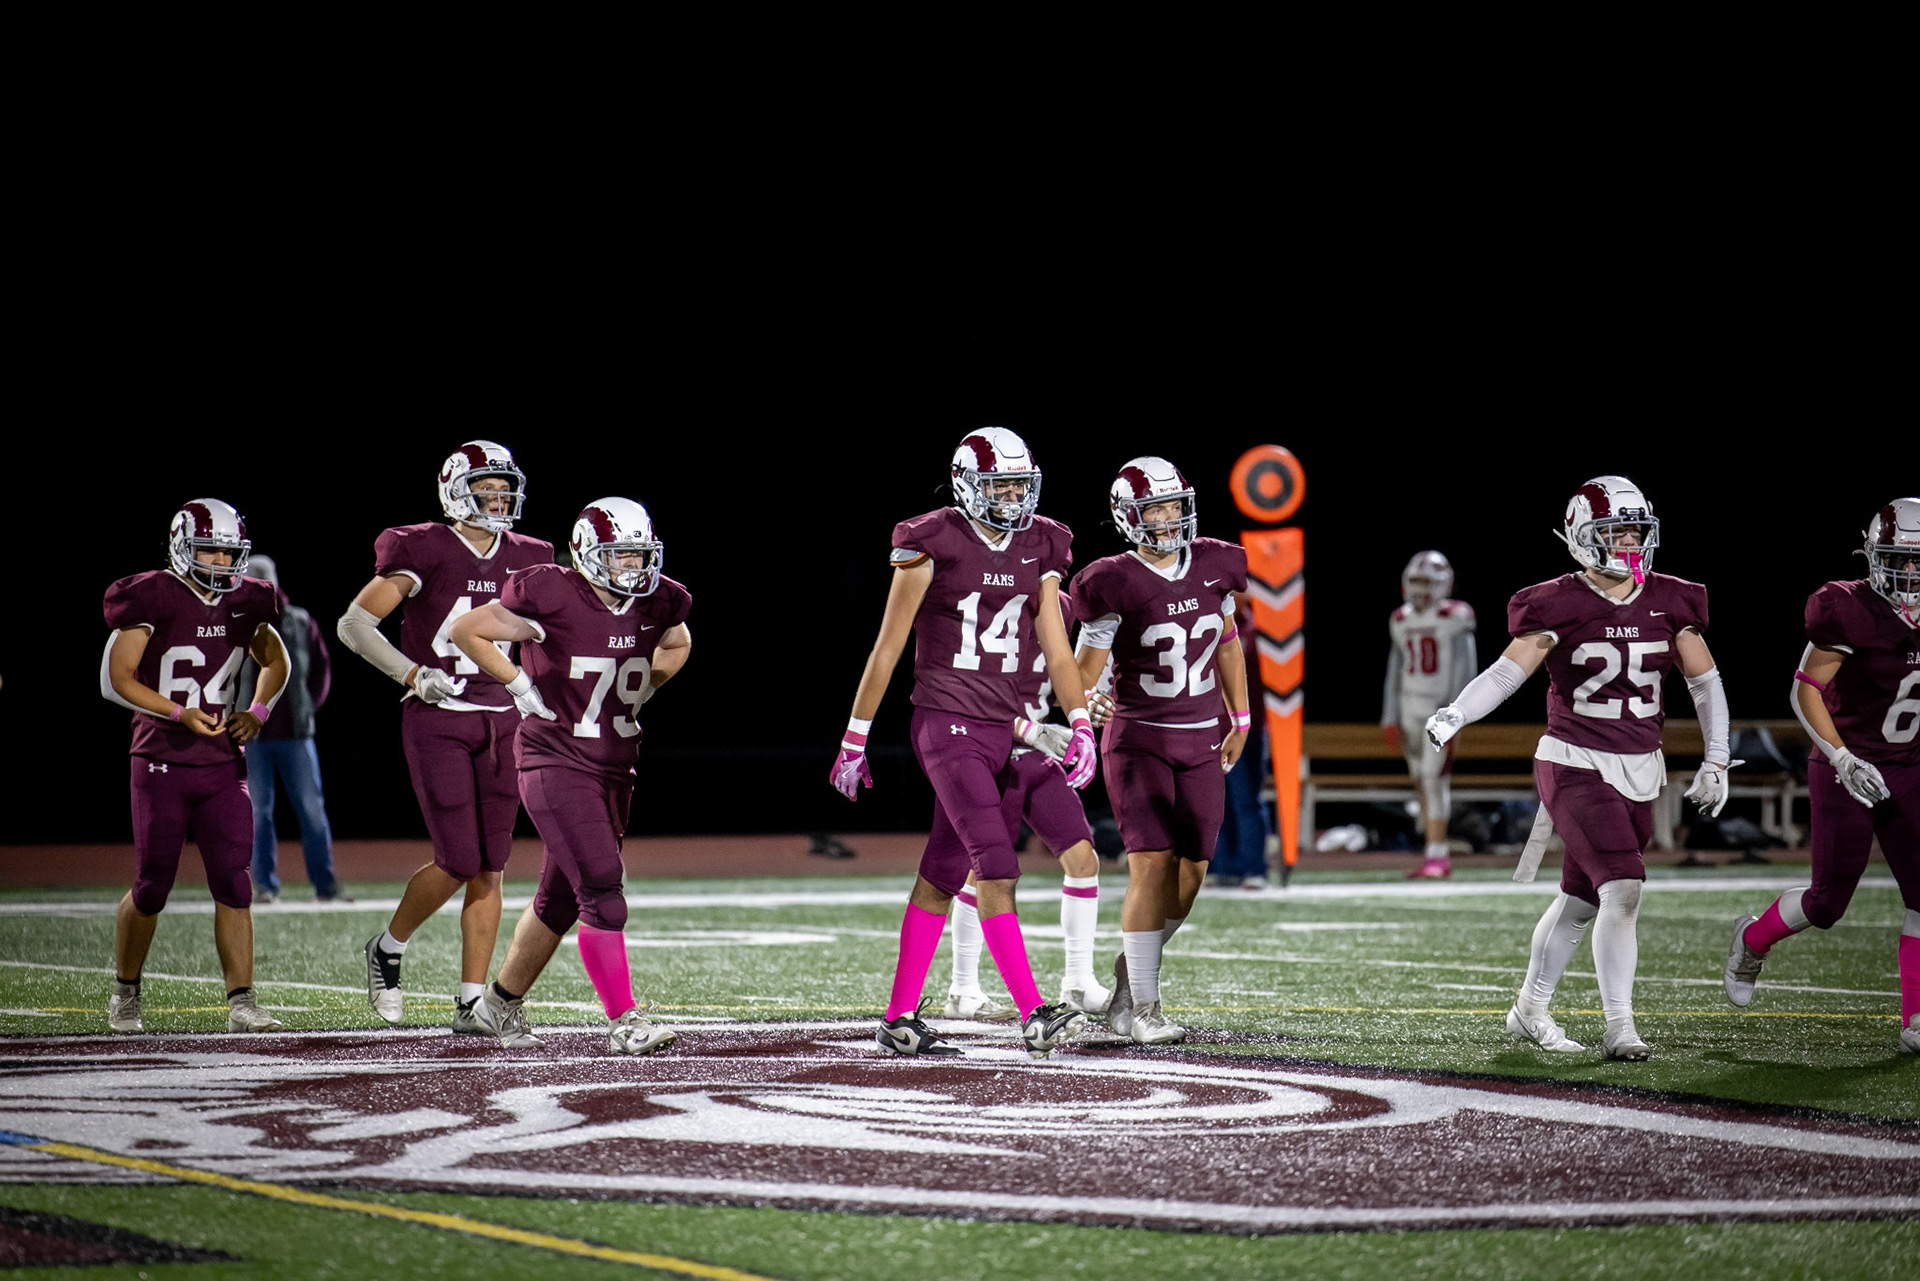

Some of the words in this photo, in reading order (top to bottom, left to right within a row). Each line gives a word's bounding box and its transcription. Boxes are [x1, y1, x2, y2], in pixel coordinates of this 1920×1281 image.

[467, 580, 497, 592] RAMS
[982, 573, 1015, 586] RAMS
[1167, 598, 1199, 616] RAMS
[196, 625, 227, 638] RAMS
[431, 596, 512, 674] 4
[607, 635, 636, 649] RAMS
[953, 592, 1029, 673] 14
[1605, 626, 1640, 639] RAMS
[1140, 613, 1224, 698] 32
[1406, 637, 1438, 675] 10
[159, 645, 244, 720] 64
[569, 655, 652, 738] 79
[1571, 641, 1670, 719] 25
